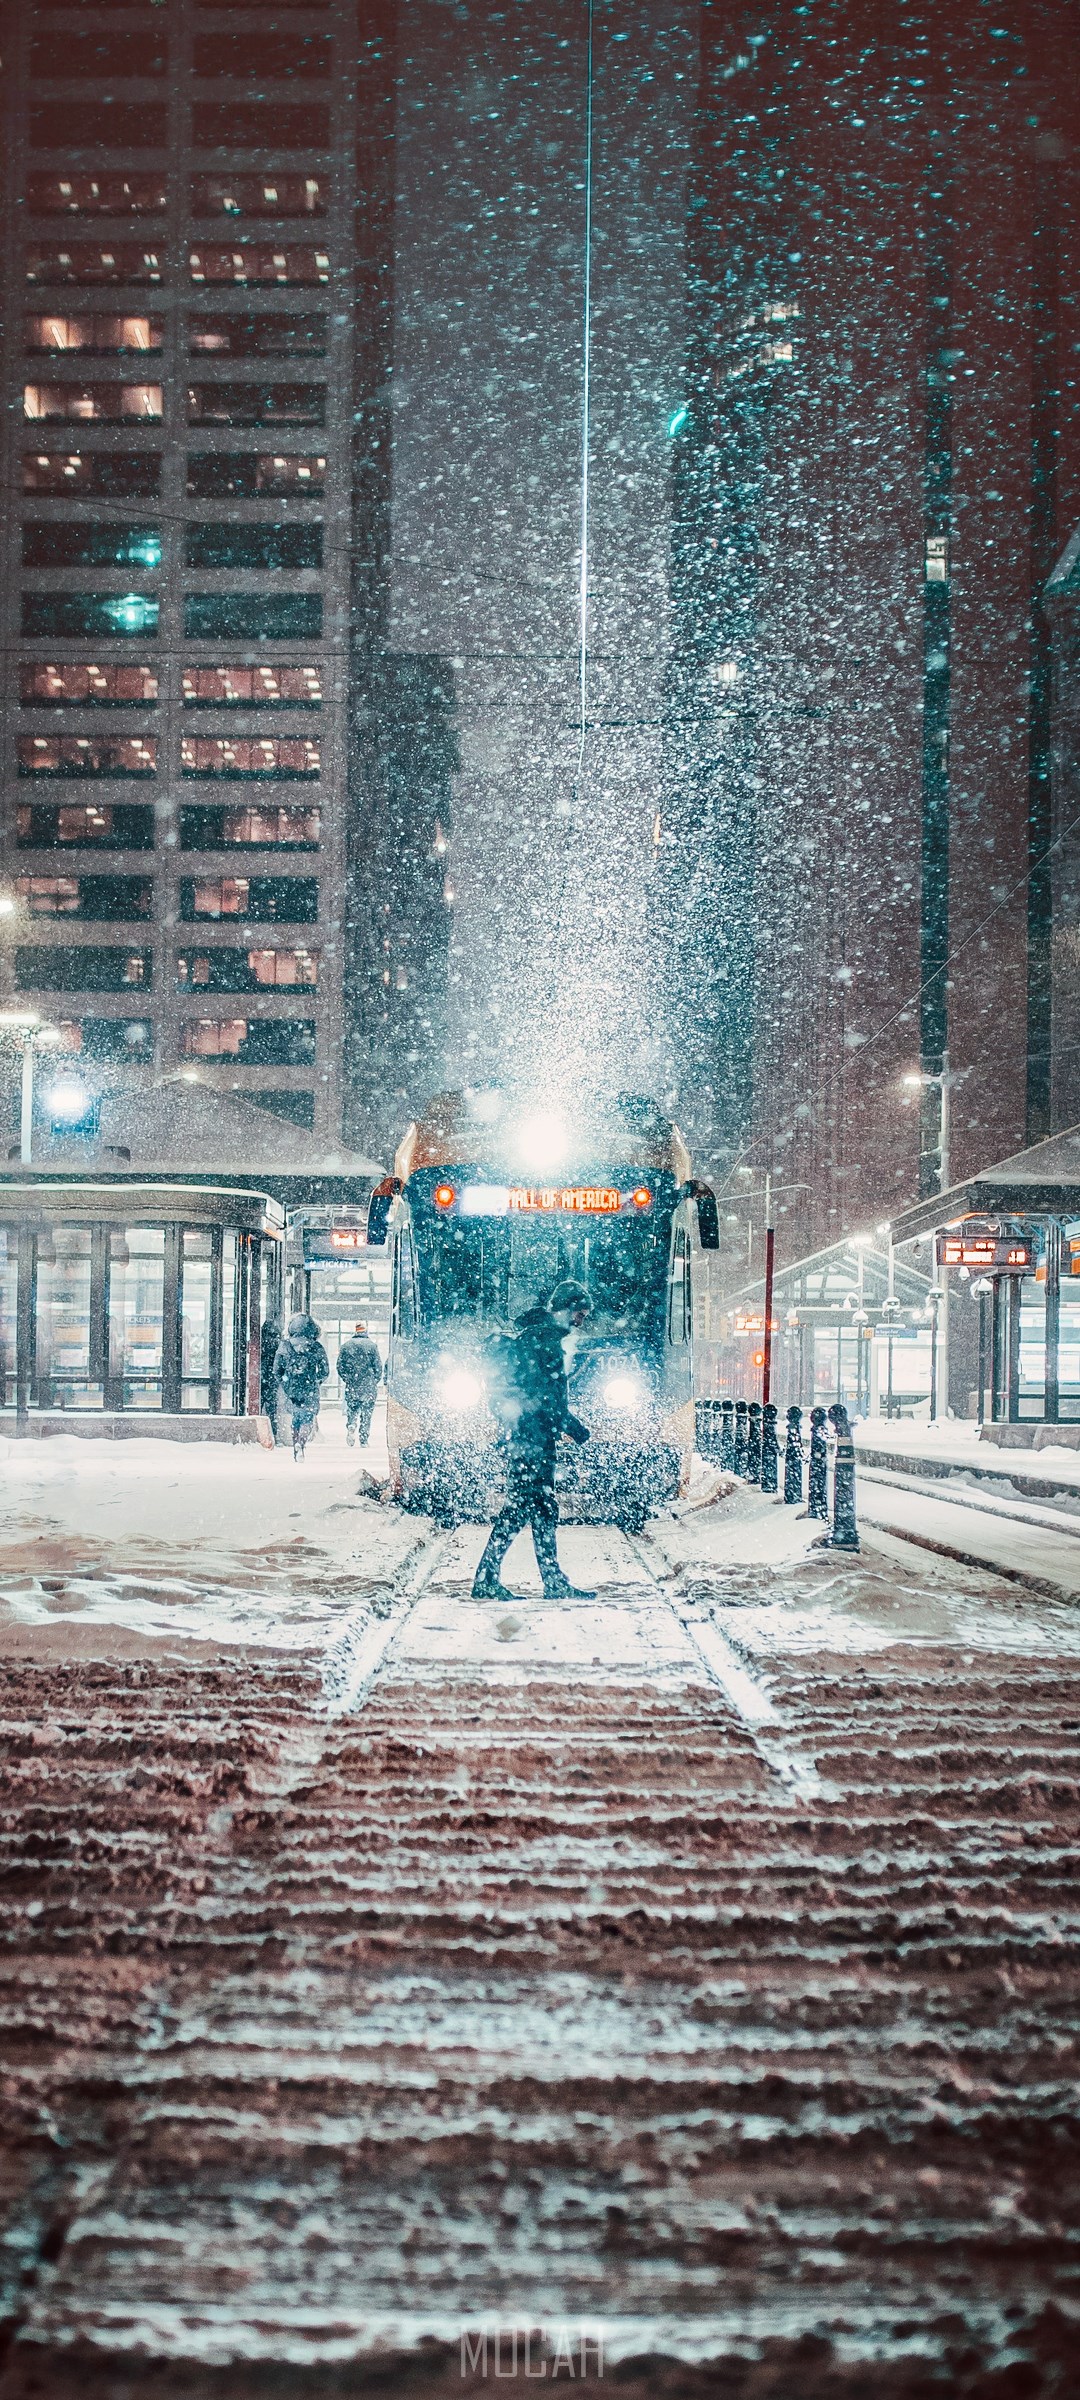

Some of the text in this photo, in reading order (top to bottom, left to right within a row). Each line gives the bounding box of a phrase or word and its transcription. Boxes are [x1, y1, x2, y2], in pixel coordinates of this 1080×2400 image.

[508, 1189, 618, 1209] MALL OF AMERICA
[320, 1260, 353, 1269] TICKETS
